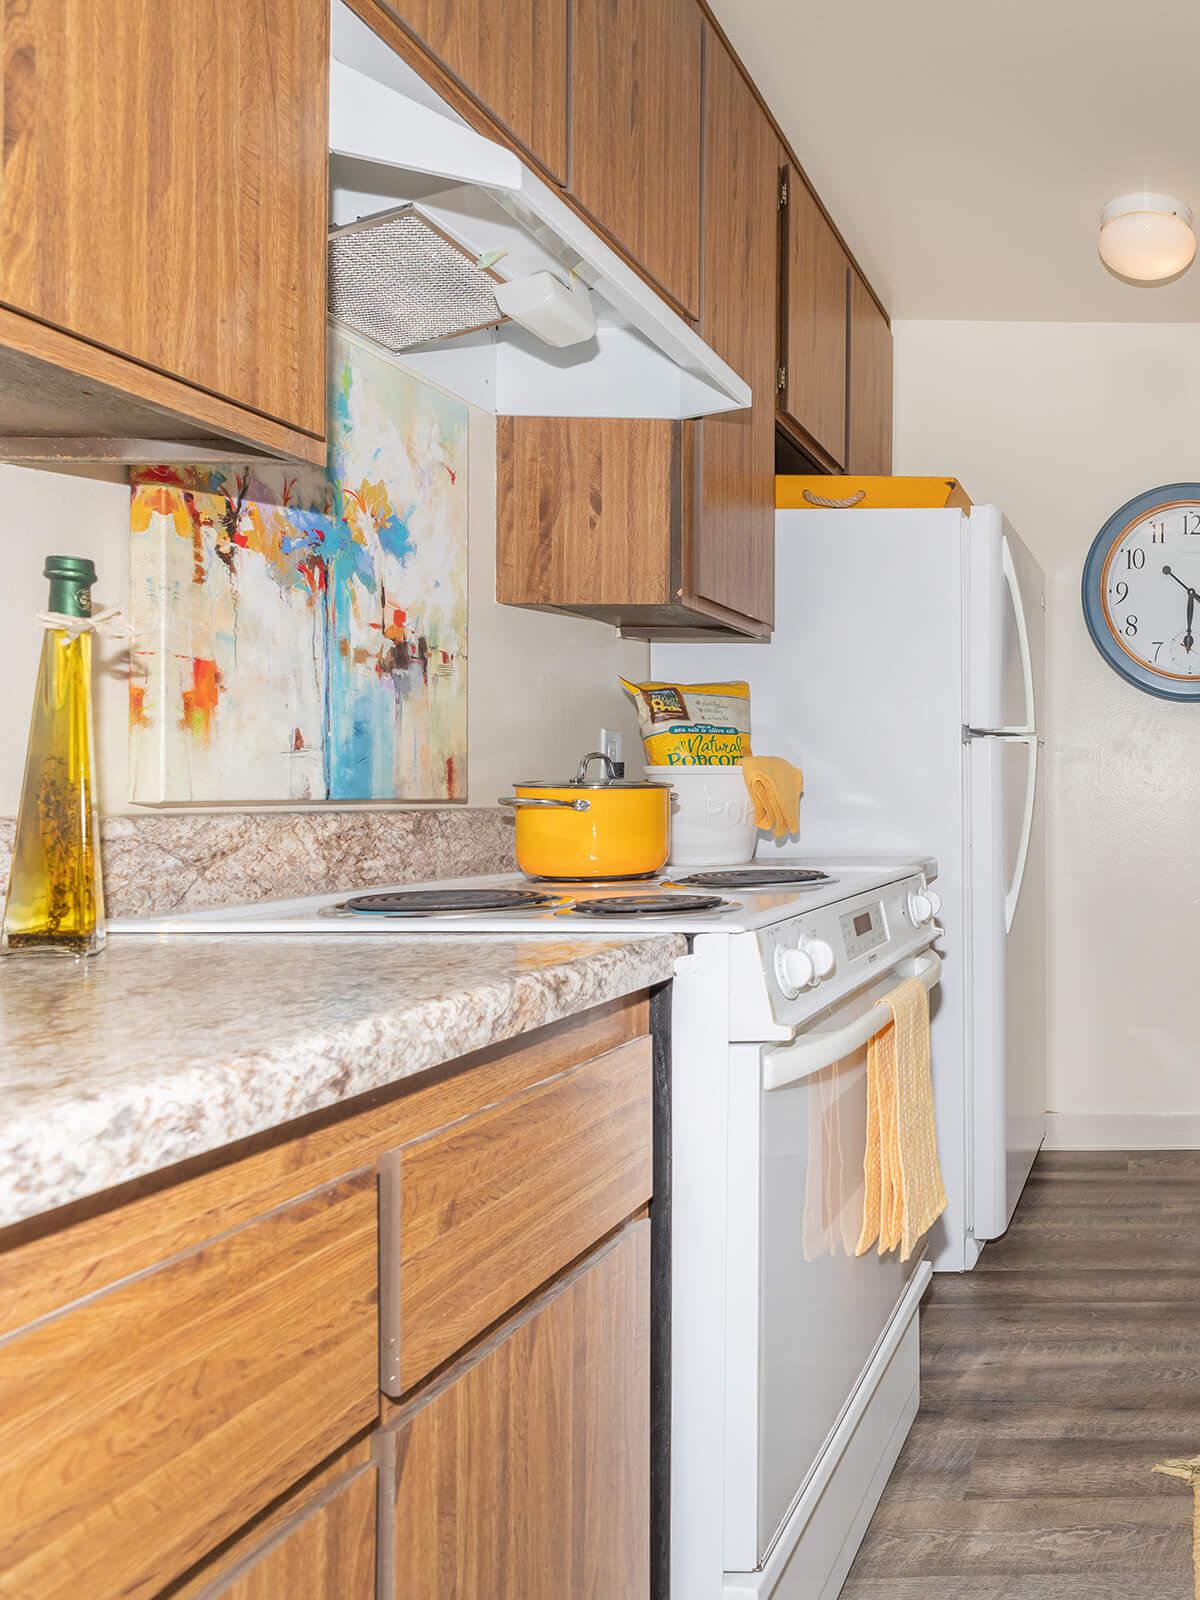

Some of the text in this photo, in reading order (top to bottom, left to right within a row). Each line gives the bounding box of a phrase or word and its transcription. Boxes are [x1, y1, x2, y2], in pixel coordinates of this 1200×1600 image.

[1152, 523, 1166, 543] 11
[1126, 548, 1145, 570] 10
[1115, 582, 1129, 605] 9
[1125, 615, 1138, 637] 8
[1152, 642, 1164, 662] 7
[688, 735, 742, 756] Natural
[667, 753, 744, 766] Popcor
